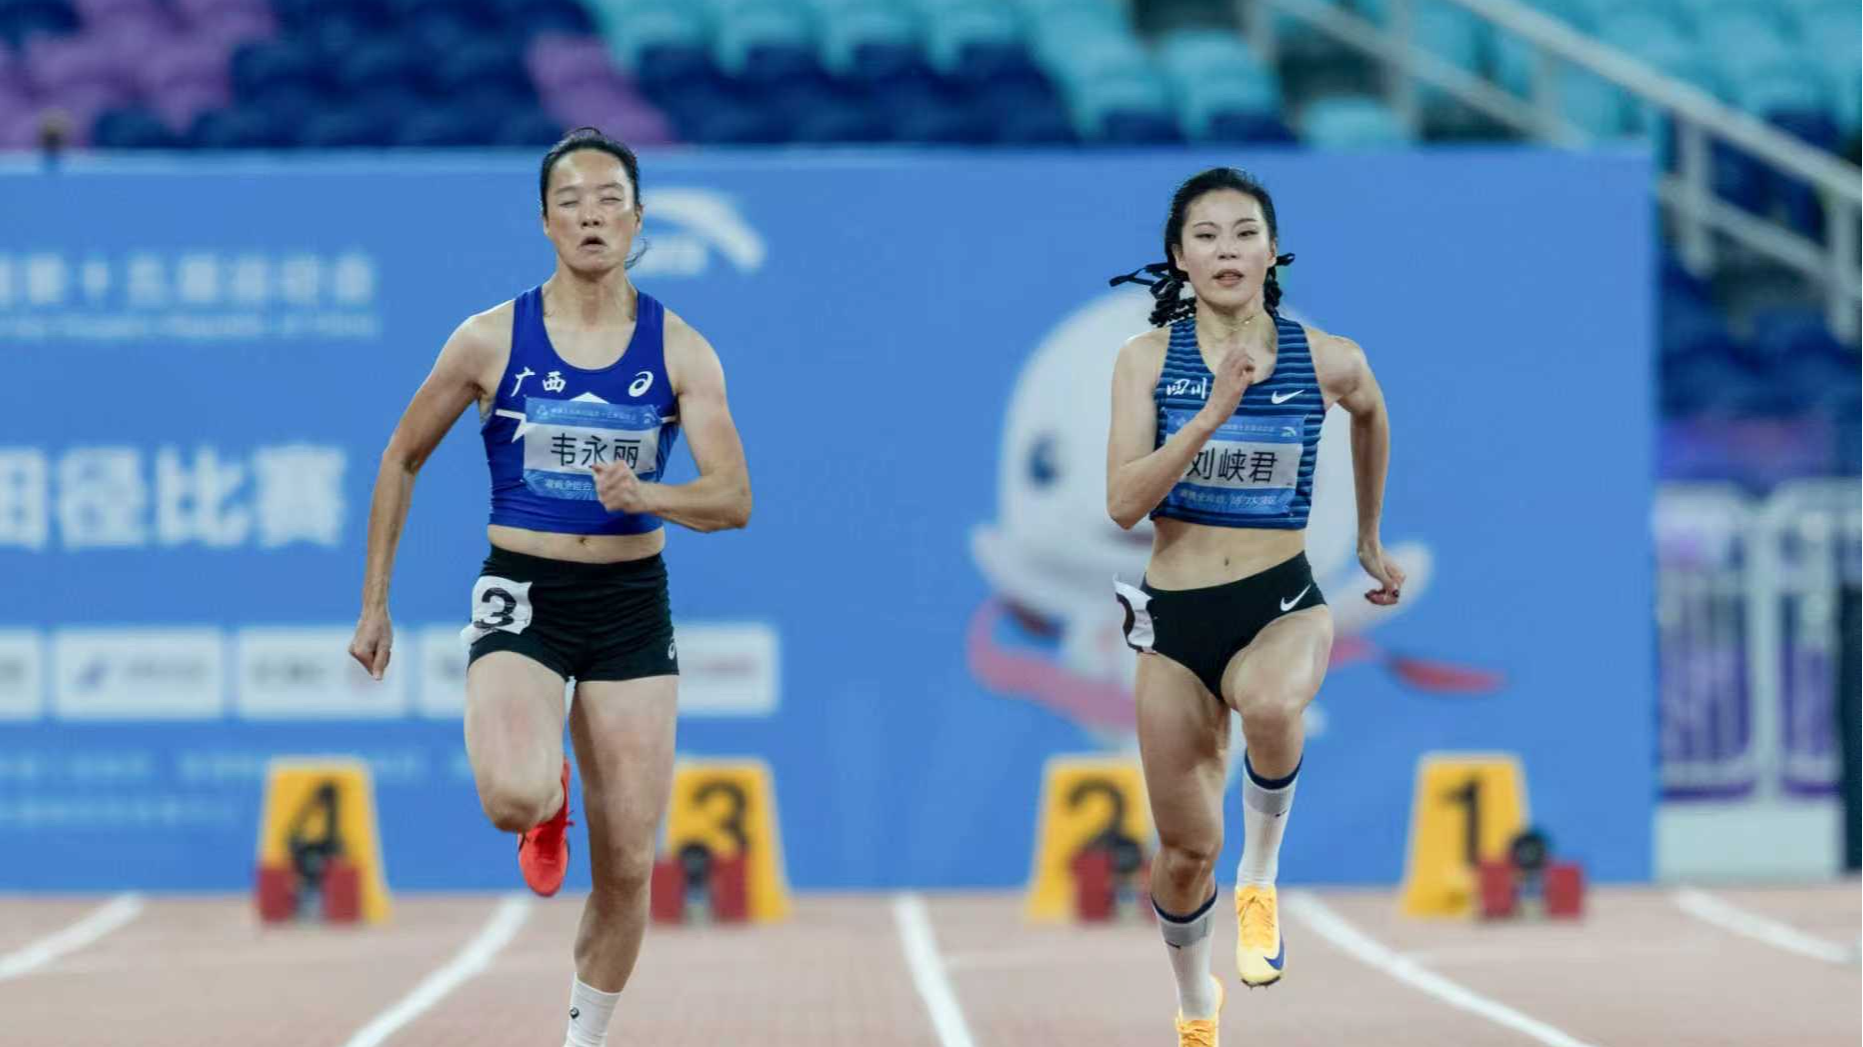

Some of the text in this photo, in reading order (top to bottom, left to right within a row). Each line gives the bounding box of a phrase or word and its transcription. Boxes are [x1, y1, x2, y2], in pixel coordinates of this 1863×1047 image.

[511, 367, 567, 397] 广西
[1166, 378, 1208, 399] 四川
[550, 432, 641, 470] 韦永丽
[1186, 447, 1278, 484] 刘峡君
[473, 587, 517, 630] 3
[287, 779, 344, 858] 4
[689, 777, 749, 850] 3
[1067, 777, 1130, 850] 2
[1443, 774, 1483, 866] 1
